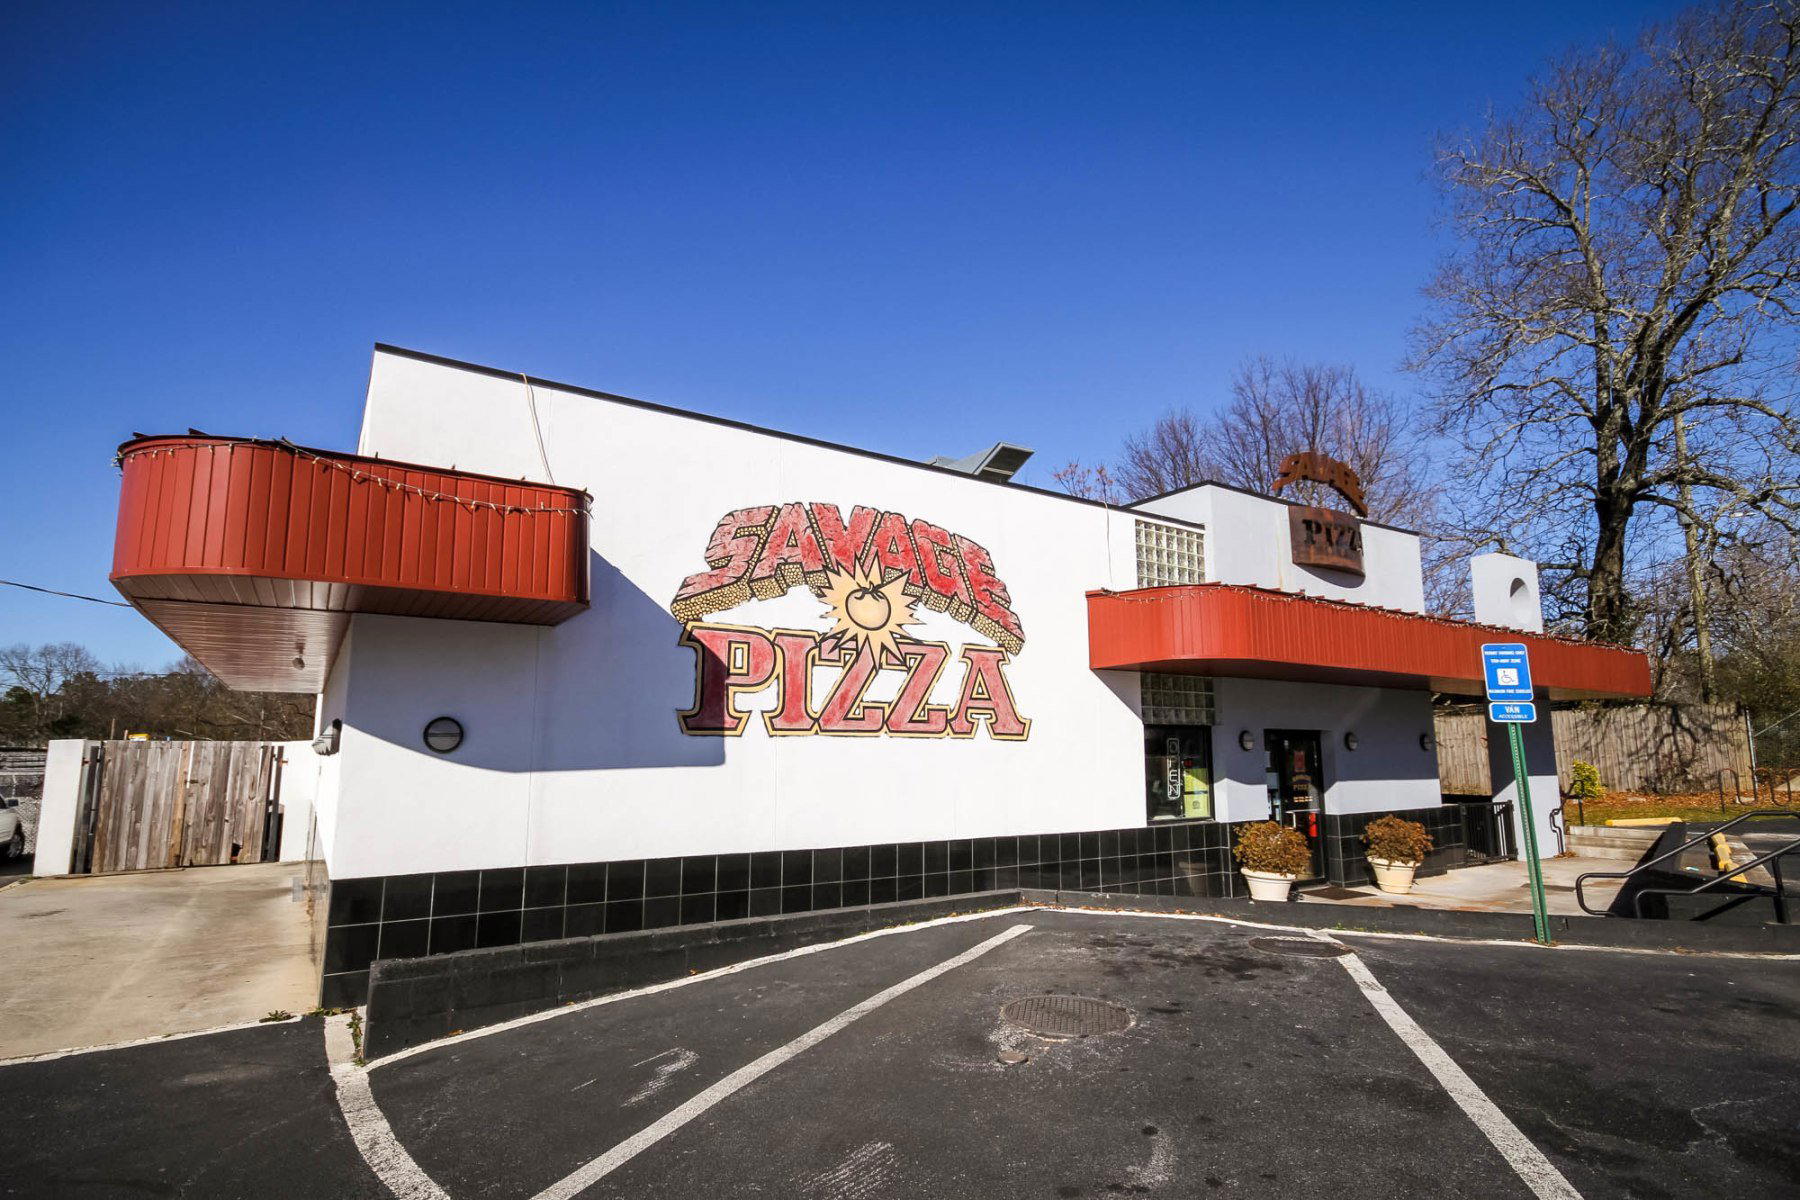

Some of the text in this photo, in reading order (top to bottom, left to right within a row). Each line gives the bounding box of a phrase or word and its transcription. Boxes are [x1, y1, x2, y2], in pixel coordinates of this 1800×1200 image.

[670, 502, 1026, 656] SAVAGE
[677, 621, 1032, 741] PIZZA
[1504, 705, 1520, 713] VAN
[1168, 740, 1179, 797] OPEN
